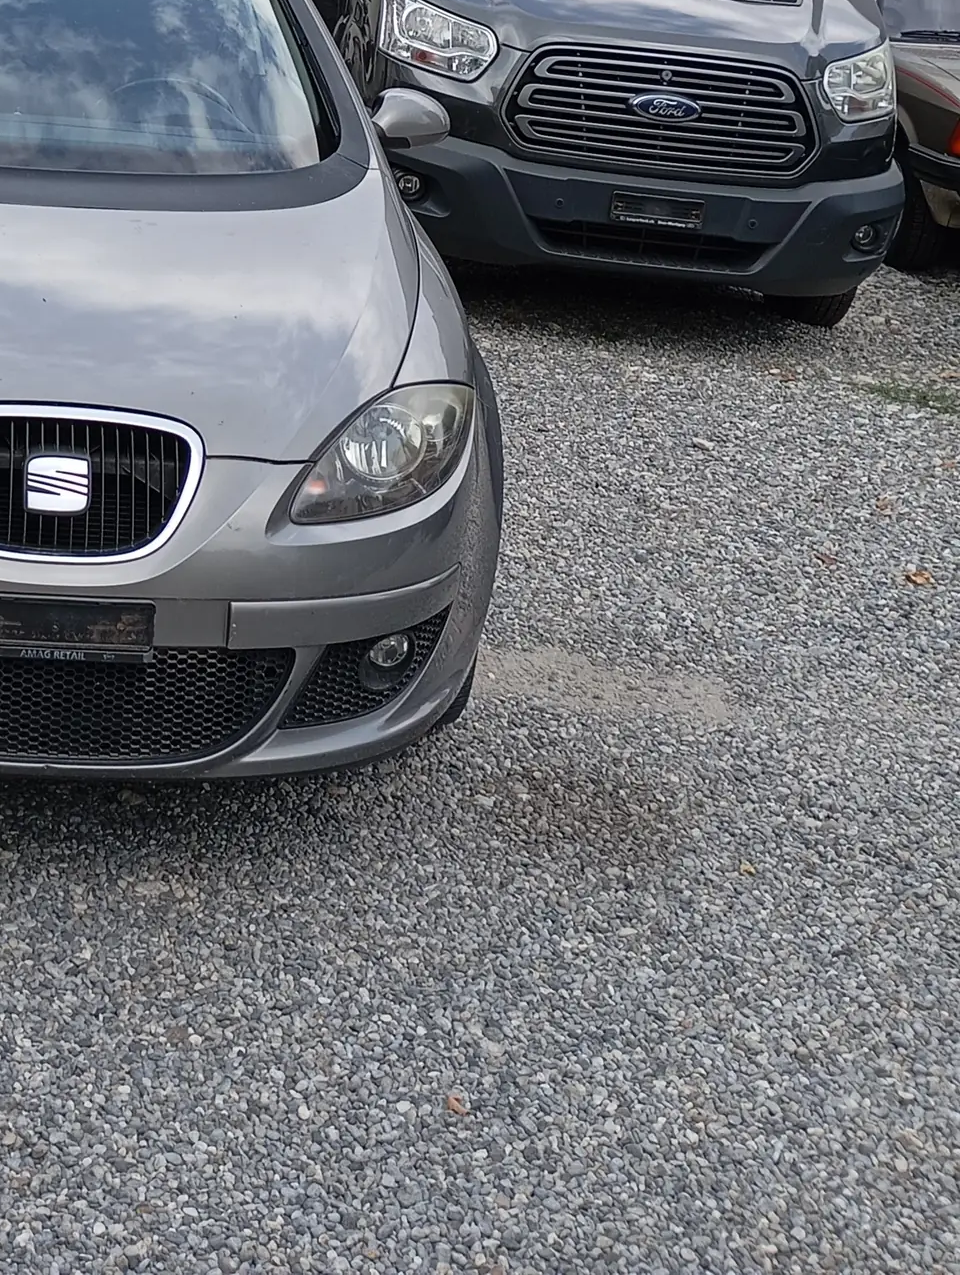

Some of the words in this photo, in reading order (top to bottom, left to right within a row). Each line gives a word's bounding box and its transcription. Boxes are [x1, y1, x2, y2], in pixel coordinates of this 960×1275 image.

[648, 98, 686, 117] Ford
[19, 649, 51, 660] AMAG
[53, 650, 86, 661] RETAIL
